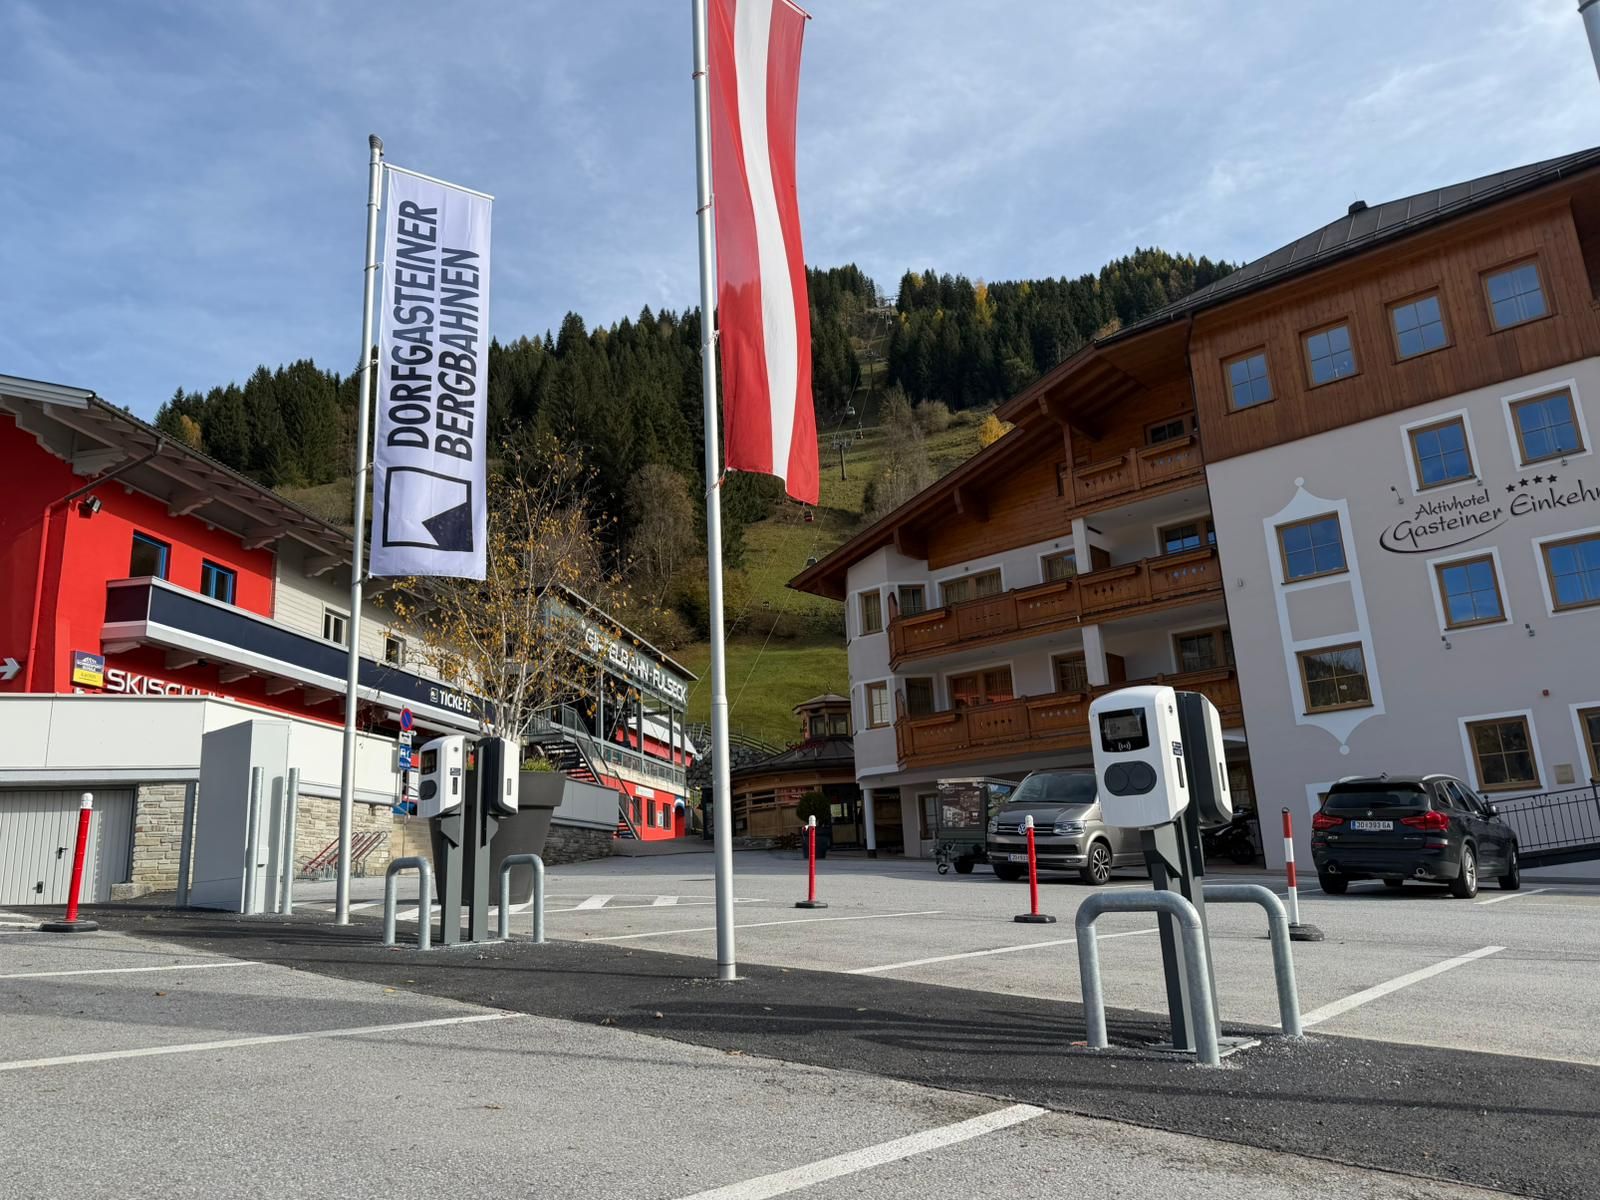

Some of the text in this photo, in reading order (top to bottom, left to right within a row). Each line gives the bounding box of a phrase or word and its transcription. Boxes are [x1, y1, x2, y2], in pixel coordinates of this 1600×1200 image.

[387, 200, 438, 449] DORFGASTEINER
[434, 247, 480, 462] BERGBAHNEN
[1414, 488, 1490, 520] Aktivhotel
[1393, 507, 1503, 548] Gasteiner
[439, 690, 472, 713] TICKETS
